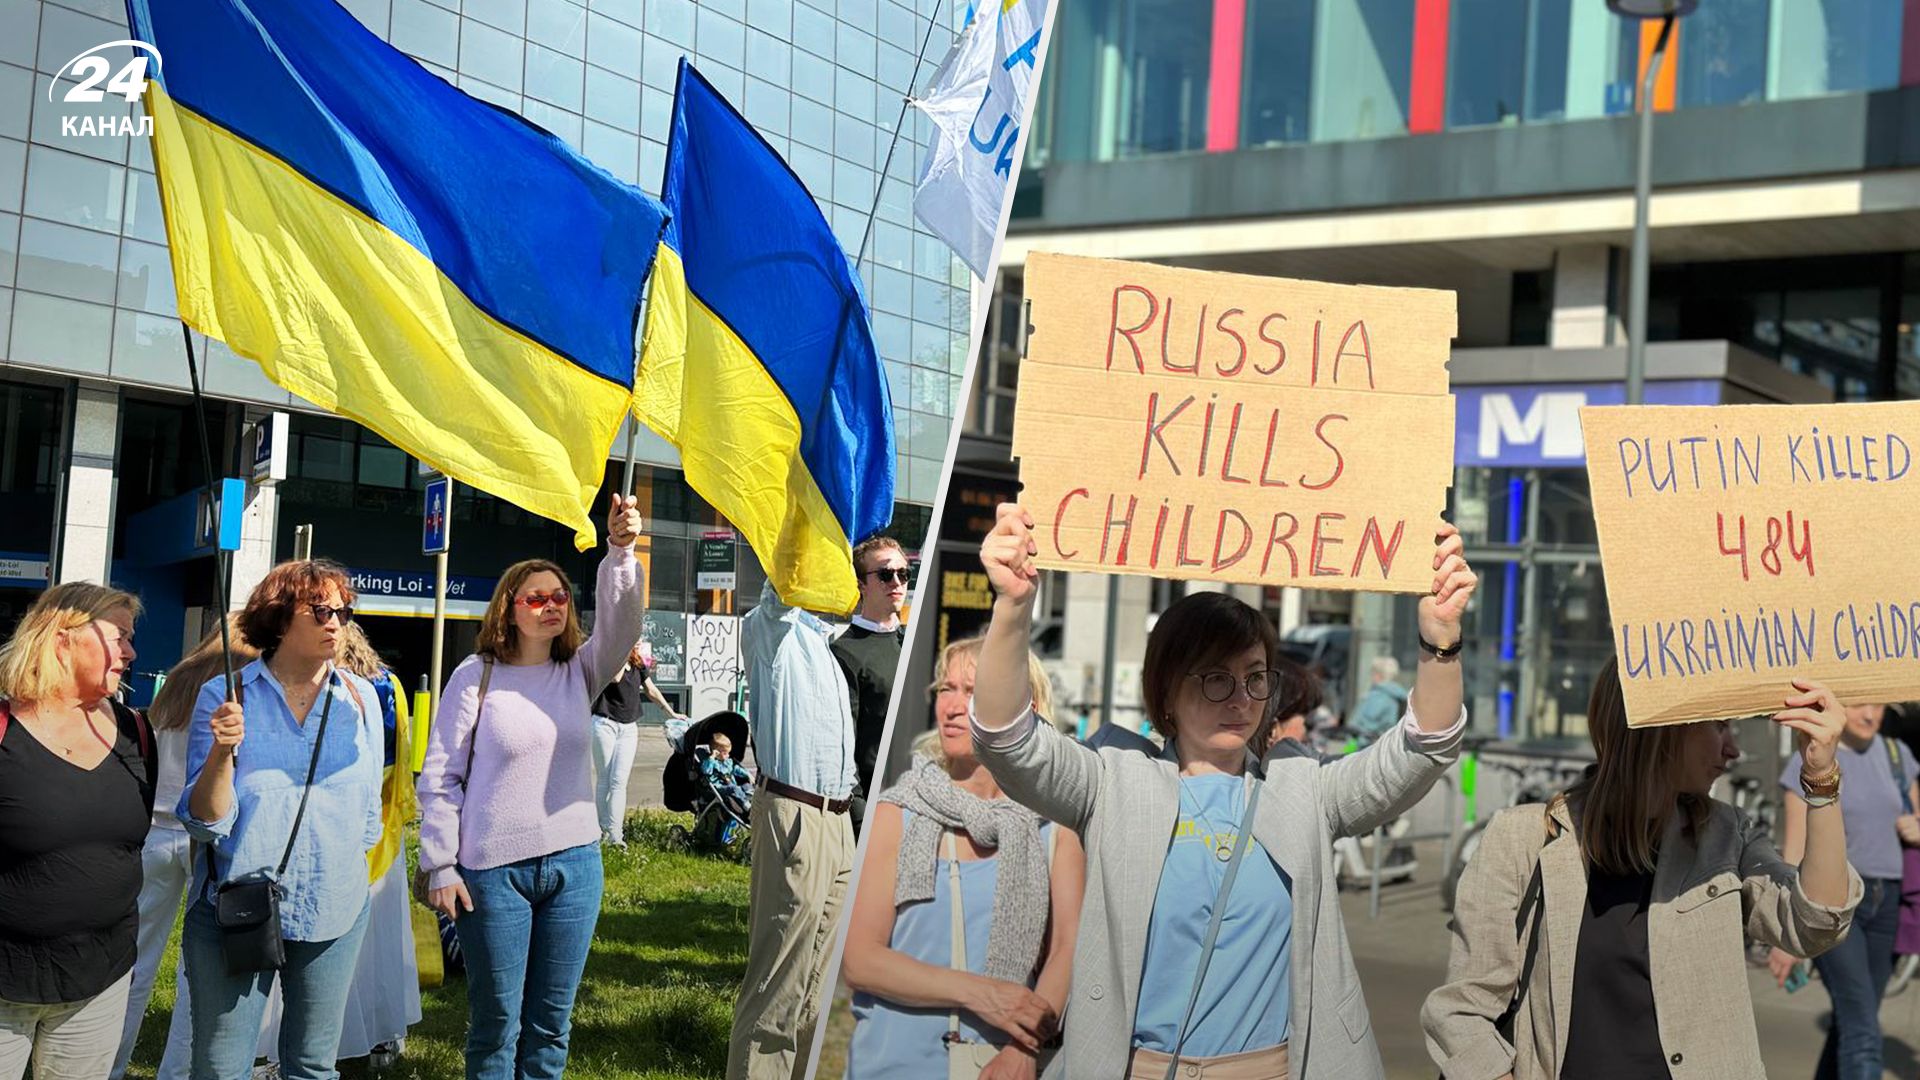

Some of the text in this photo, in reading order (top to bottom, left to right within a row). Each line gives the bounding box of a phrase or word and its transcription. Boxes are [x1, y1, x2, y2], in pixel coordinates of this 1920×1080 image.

[1106, 284, 1375, 389] RUSSIA
[1618, 424, 1761, 498] PUTIN
[1716, 510, 1815, 582] 484
[349, 574, 393, 593] rking
[397, 576, 423, 592] Loi
[691, 620, 734, 637] NON
[700, 636, 726, 657] AU
